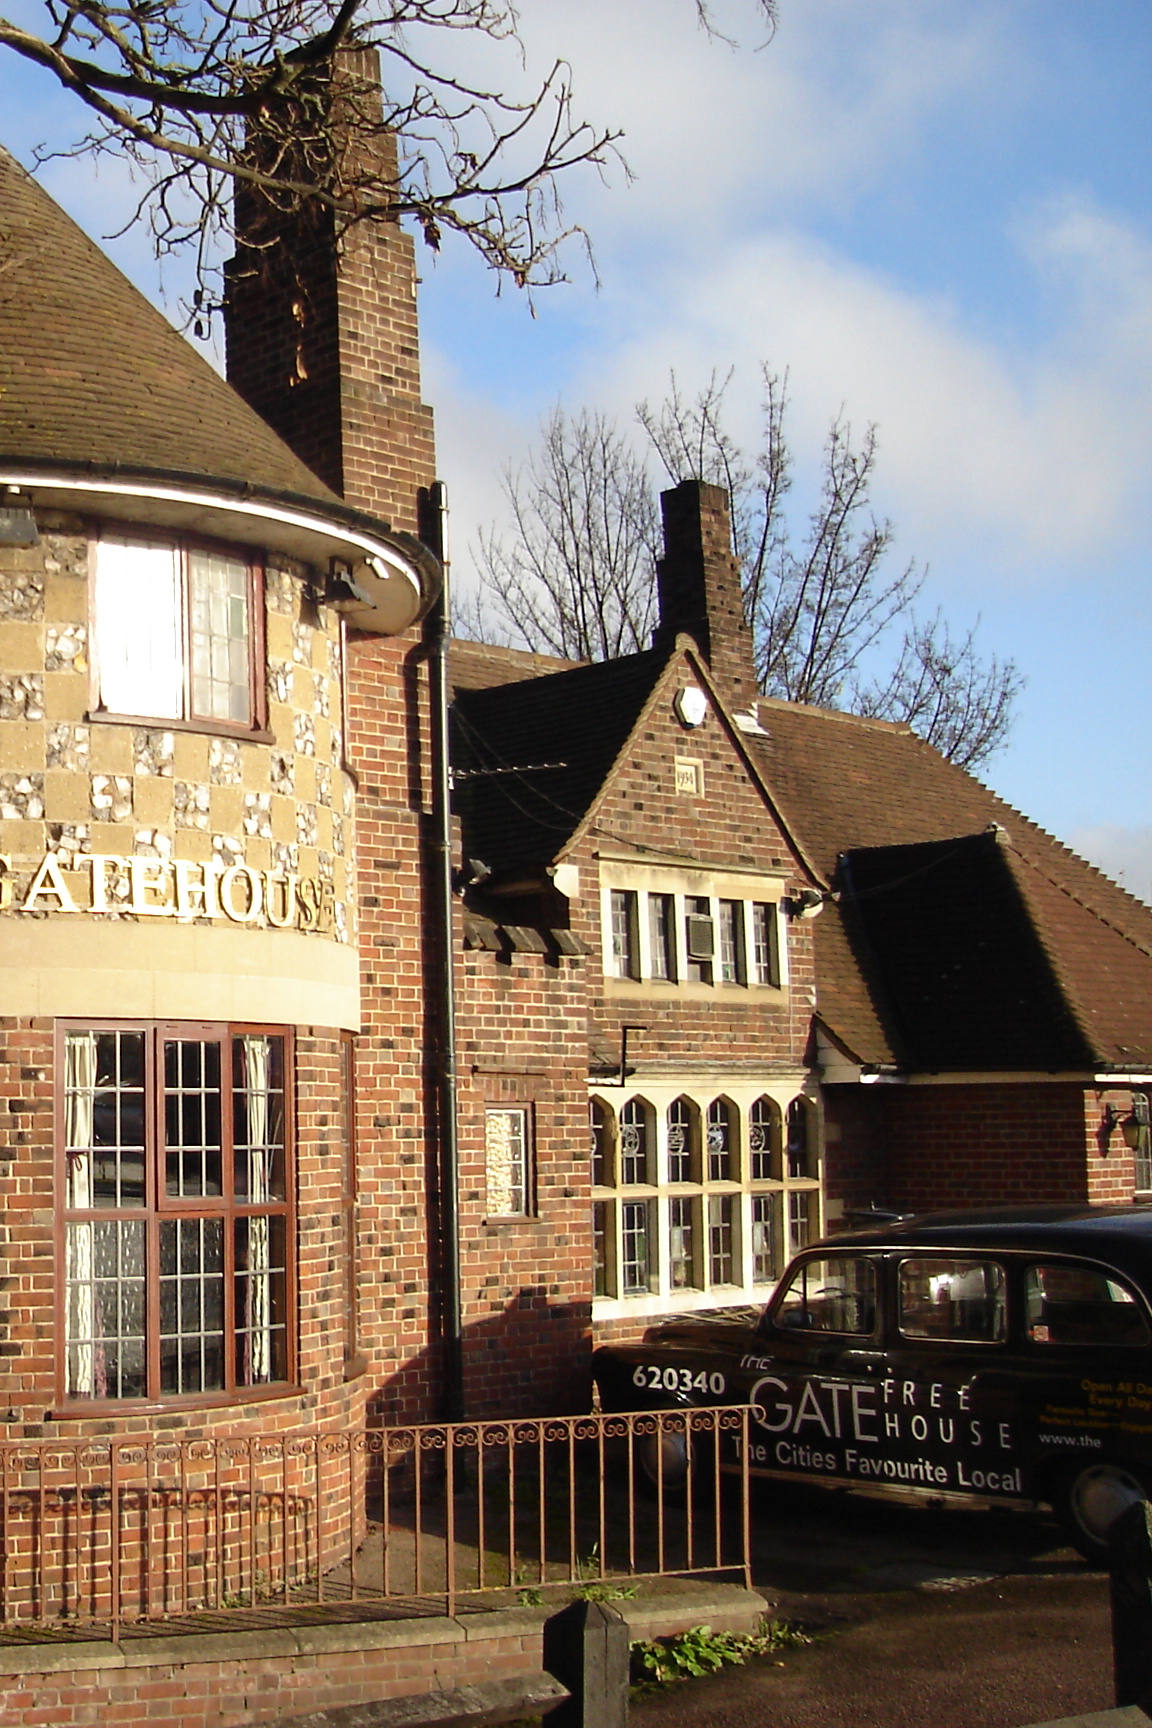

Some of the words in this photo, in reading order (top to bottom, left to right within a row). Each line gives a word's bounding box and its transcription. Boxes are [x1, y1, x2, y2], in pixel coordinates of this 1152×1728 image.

[740, 1354, 775, 1370] THE
[632, 1365, 726, 1395] 620340
[883, 1378, 970, 1411] FREE
[1080, 1379, 1113, 1392] Open
[749, 1376, 879, 1443] GATE
[884, 1412, 1012, 1449] HOUSE
[1038, 1433, 1102, 1448] www.the
[775, 1441, 837, 1471] Cities
[845, 1449, 948, 1483] Favourite
[957, 1461, 1022, 1492] Local
